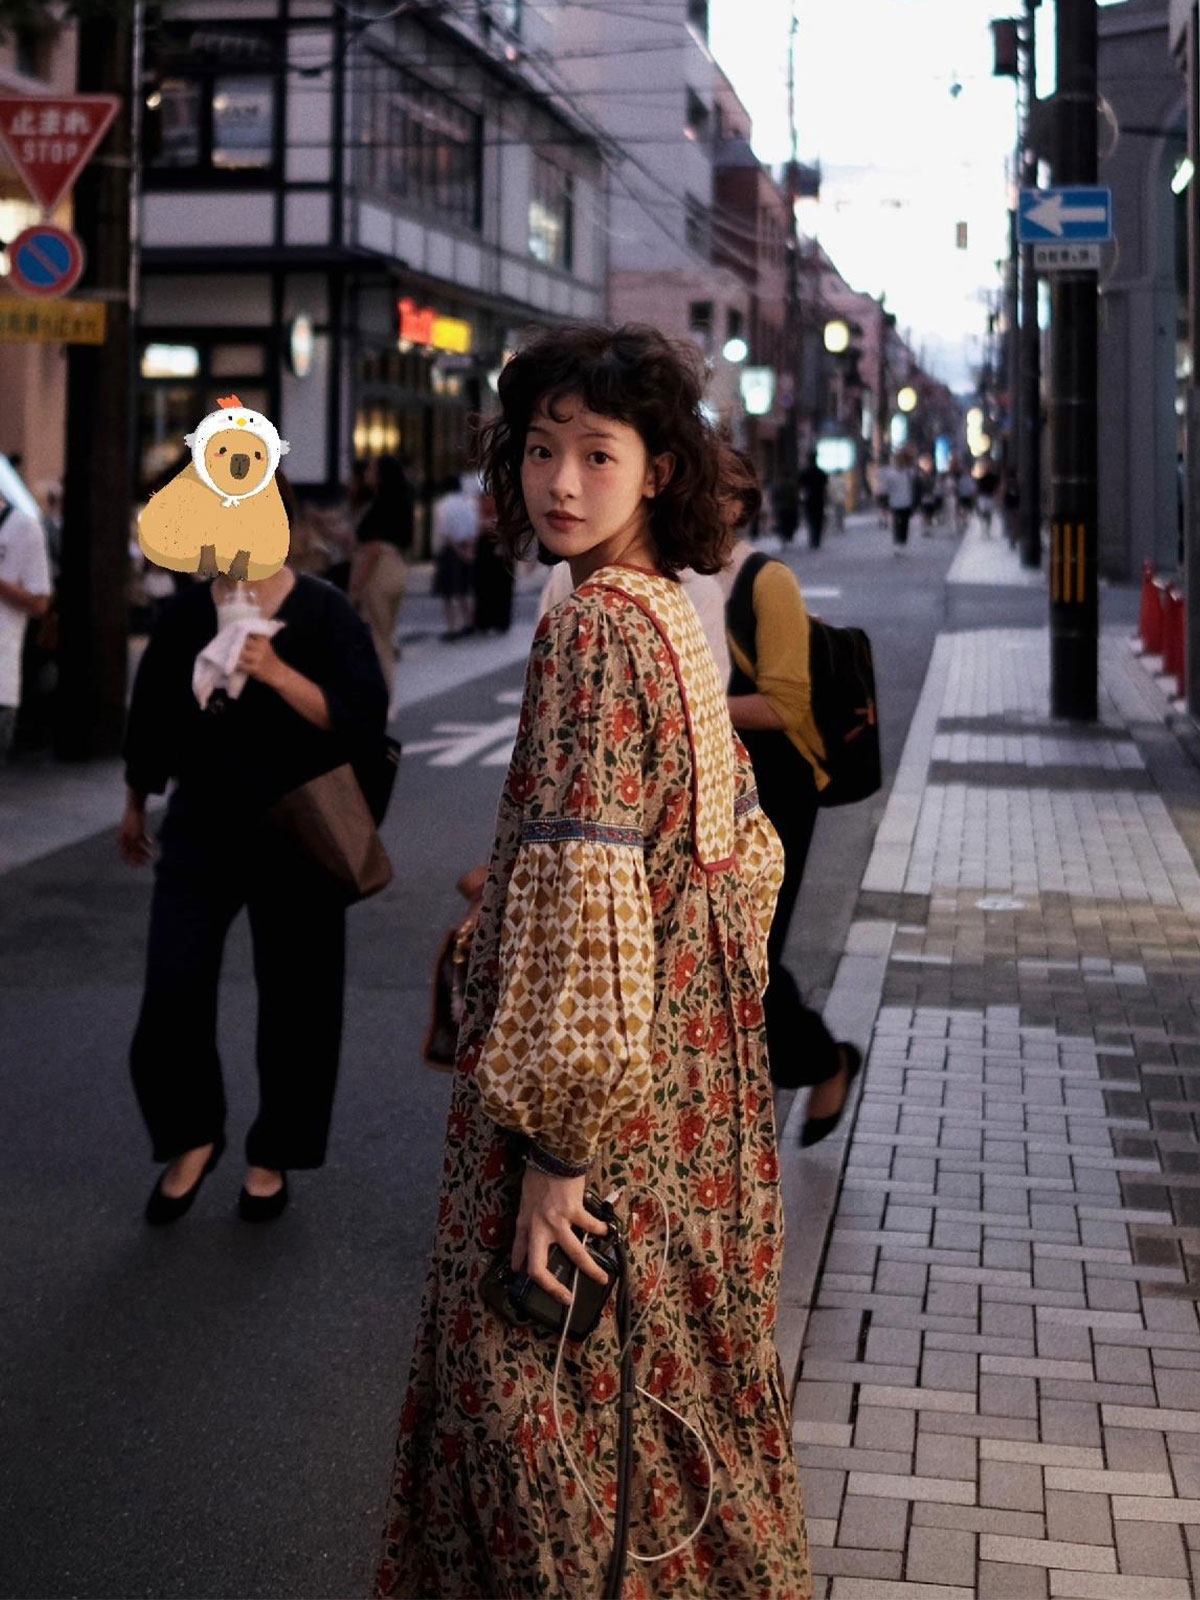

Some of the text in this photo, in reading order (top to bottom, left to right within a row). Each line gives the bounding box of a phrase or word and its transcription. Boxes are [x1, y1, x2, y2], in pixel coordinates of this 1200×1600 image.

[9, 109, 89, 136] 止まれ
[23, 139, 78, 164] STOP
